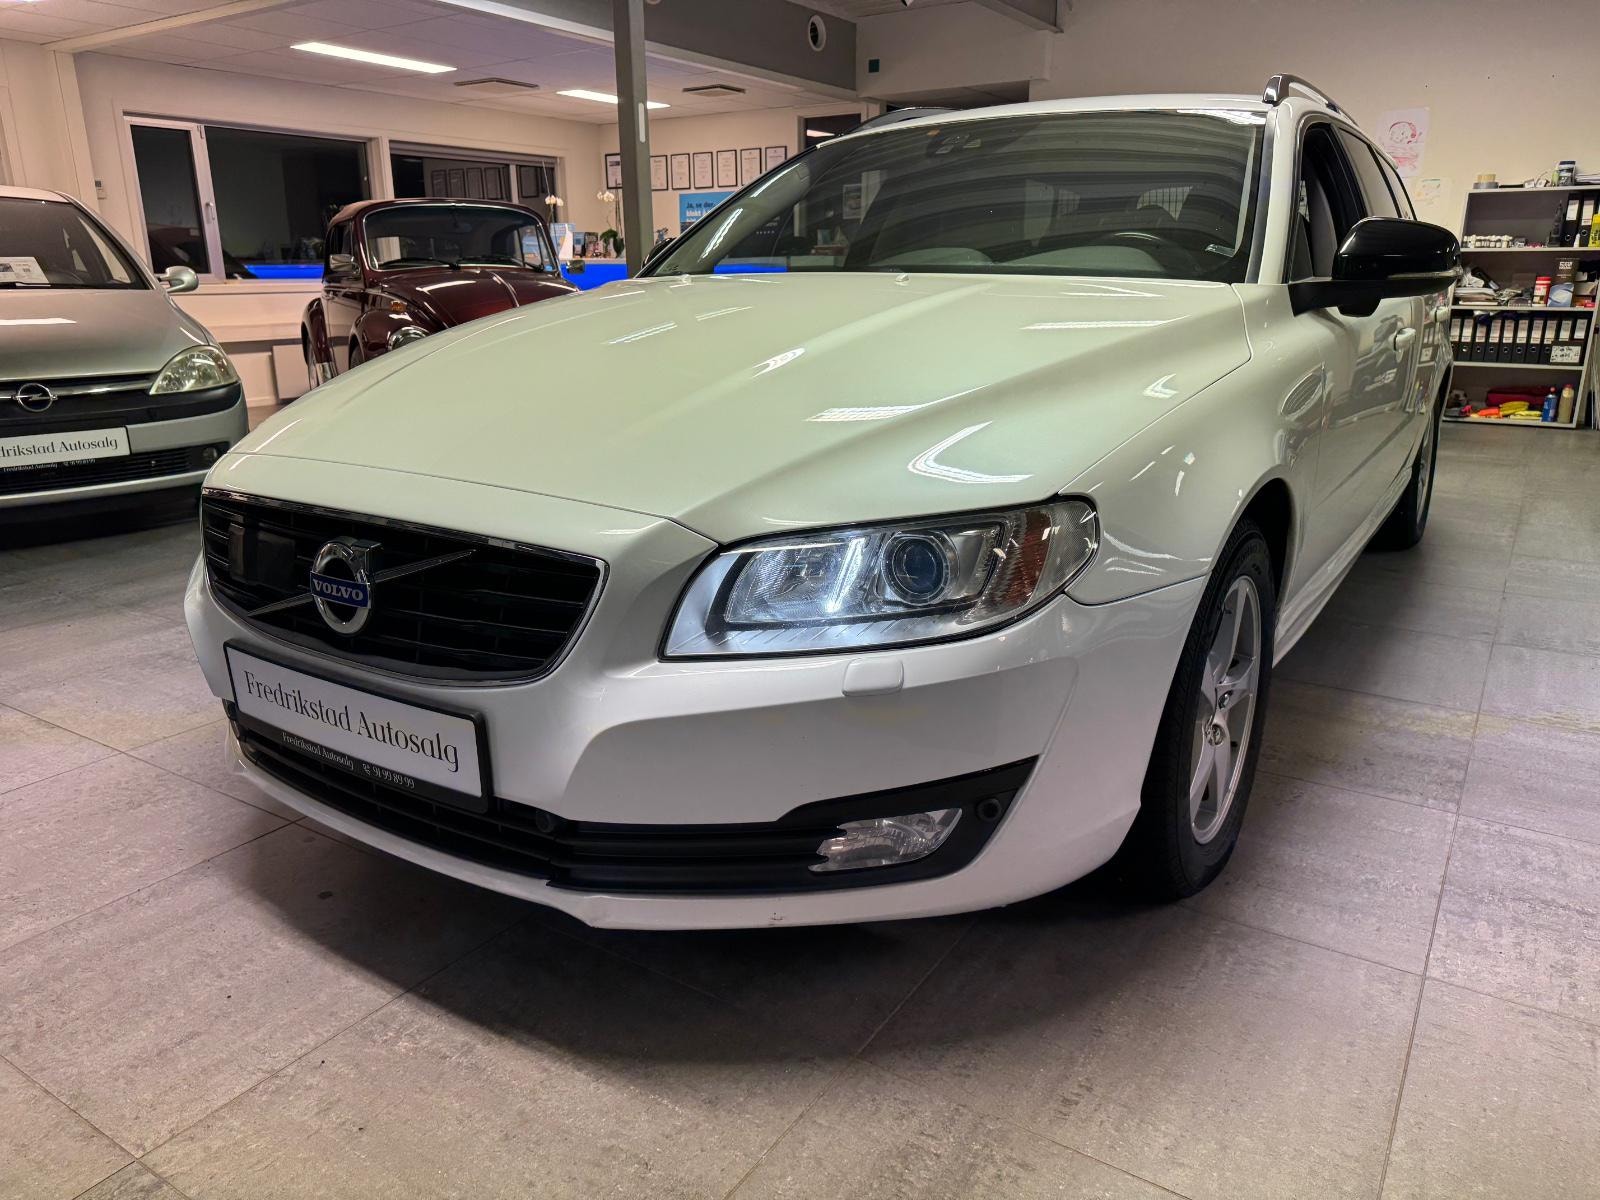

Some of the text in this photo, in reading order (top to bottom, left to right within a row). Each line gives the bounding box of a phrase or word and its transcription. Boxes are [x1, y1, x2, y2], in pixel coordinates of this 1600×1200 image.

[59, 436, 118, 453] Autosalg
[312, 578, 364, 601] VOLVO
[243, 670, 459, 773] Fredrikstad Autosalg
[282, 731, 321, 756] Fredrikstad
[322, 747, 354, 771] Autosalg
[372, 765, 381, 778] 91
[382, 769, 392, 781] 99
[403, 775, 415, 789] 99
